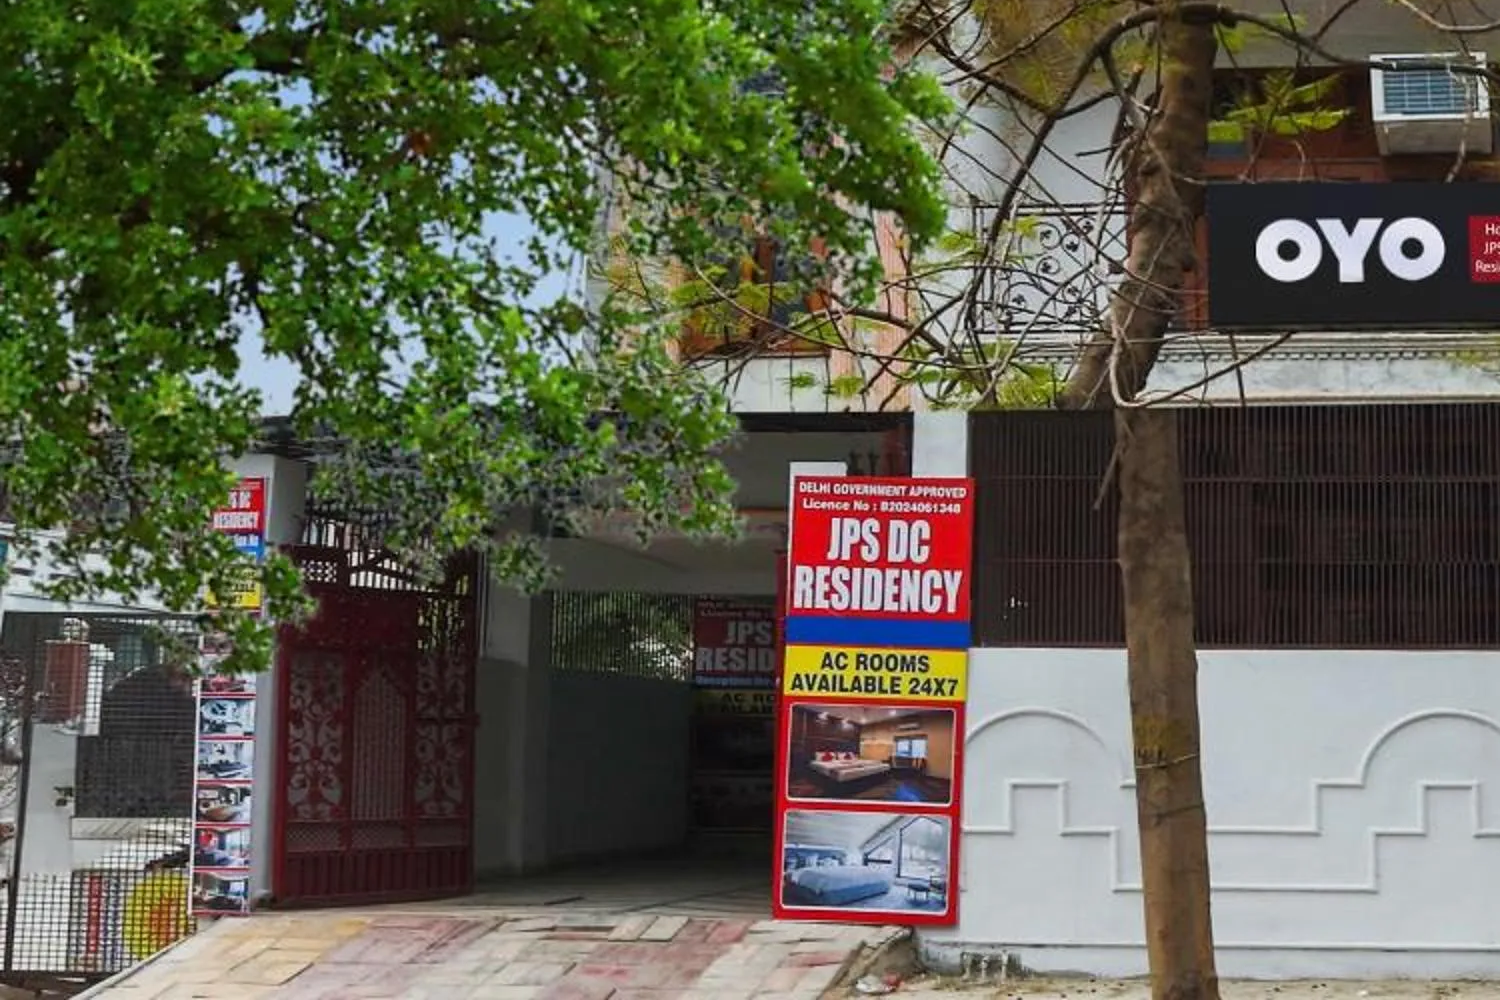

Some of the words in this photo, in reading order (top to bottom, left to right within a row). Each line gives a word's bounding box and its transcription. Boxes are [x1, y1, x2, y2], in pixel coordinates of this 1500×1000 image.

[1255, 217, 1446, 283] OYO
[799, 481, 831, 494] DELHI
[833, 482, 906, 497] GOVERNMENT
[909, 486, 967, 499] APPROVED
[803, 498, 850, 511] Licence
[853, 500, 870, 512] No
[827, 517, 881, 563] JPS
[888, 519, 931, 564] DC
[793, 565, 963, 614] RESIDENCY
[723, 620, 773, 645] JPS
[820, 652, 849, 671] AC
[855, 653, 930, 673] ROOMS
[791, 673, 906, 695] AVAILABLE
[908, 677, 959, 696] 24X7
